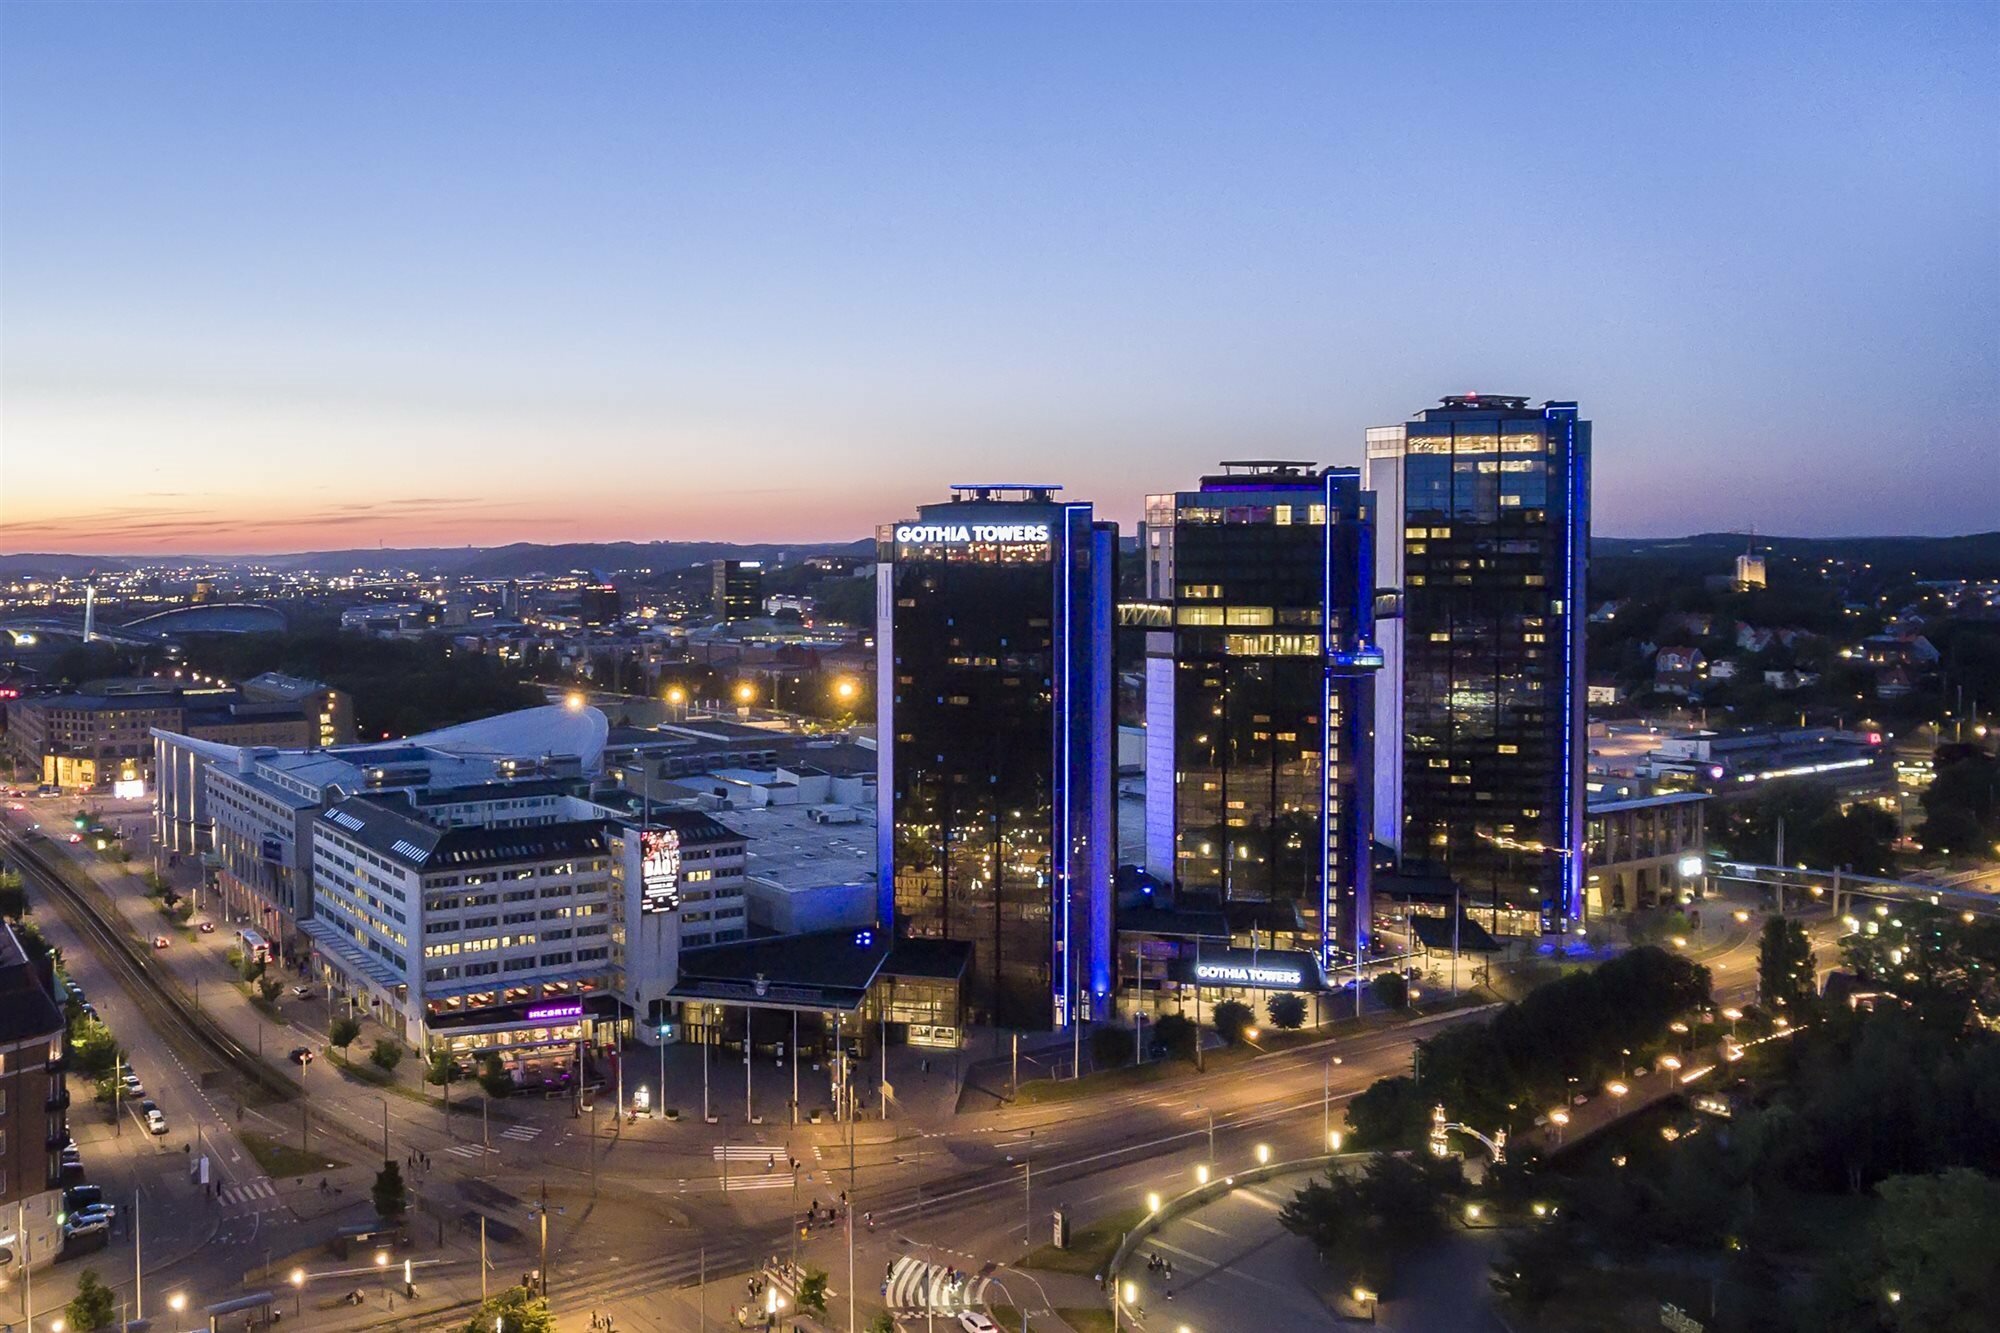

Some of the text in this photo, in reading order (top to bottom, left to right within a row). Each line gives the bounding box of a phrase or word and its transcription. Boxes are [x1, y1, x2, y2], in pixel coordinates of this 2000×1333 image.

[896, 525, 1049, 542] GOTHIA TOWERS
[1197, 965, 1301, 984] GOTHIA TOWERS
